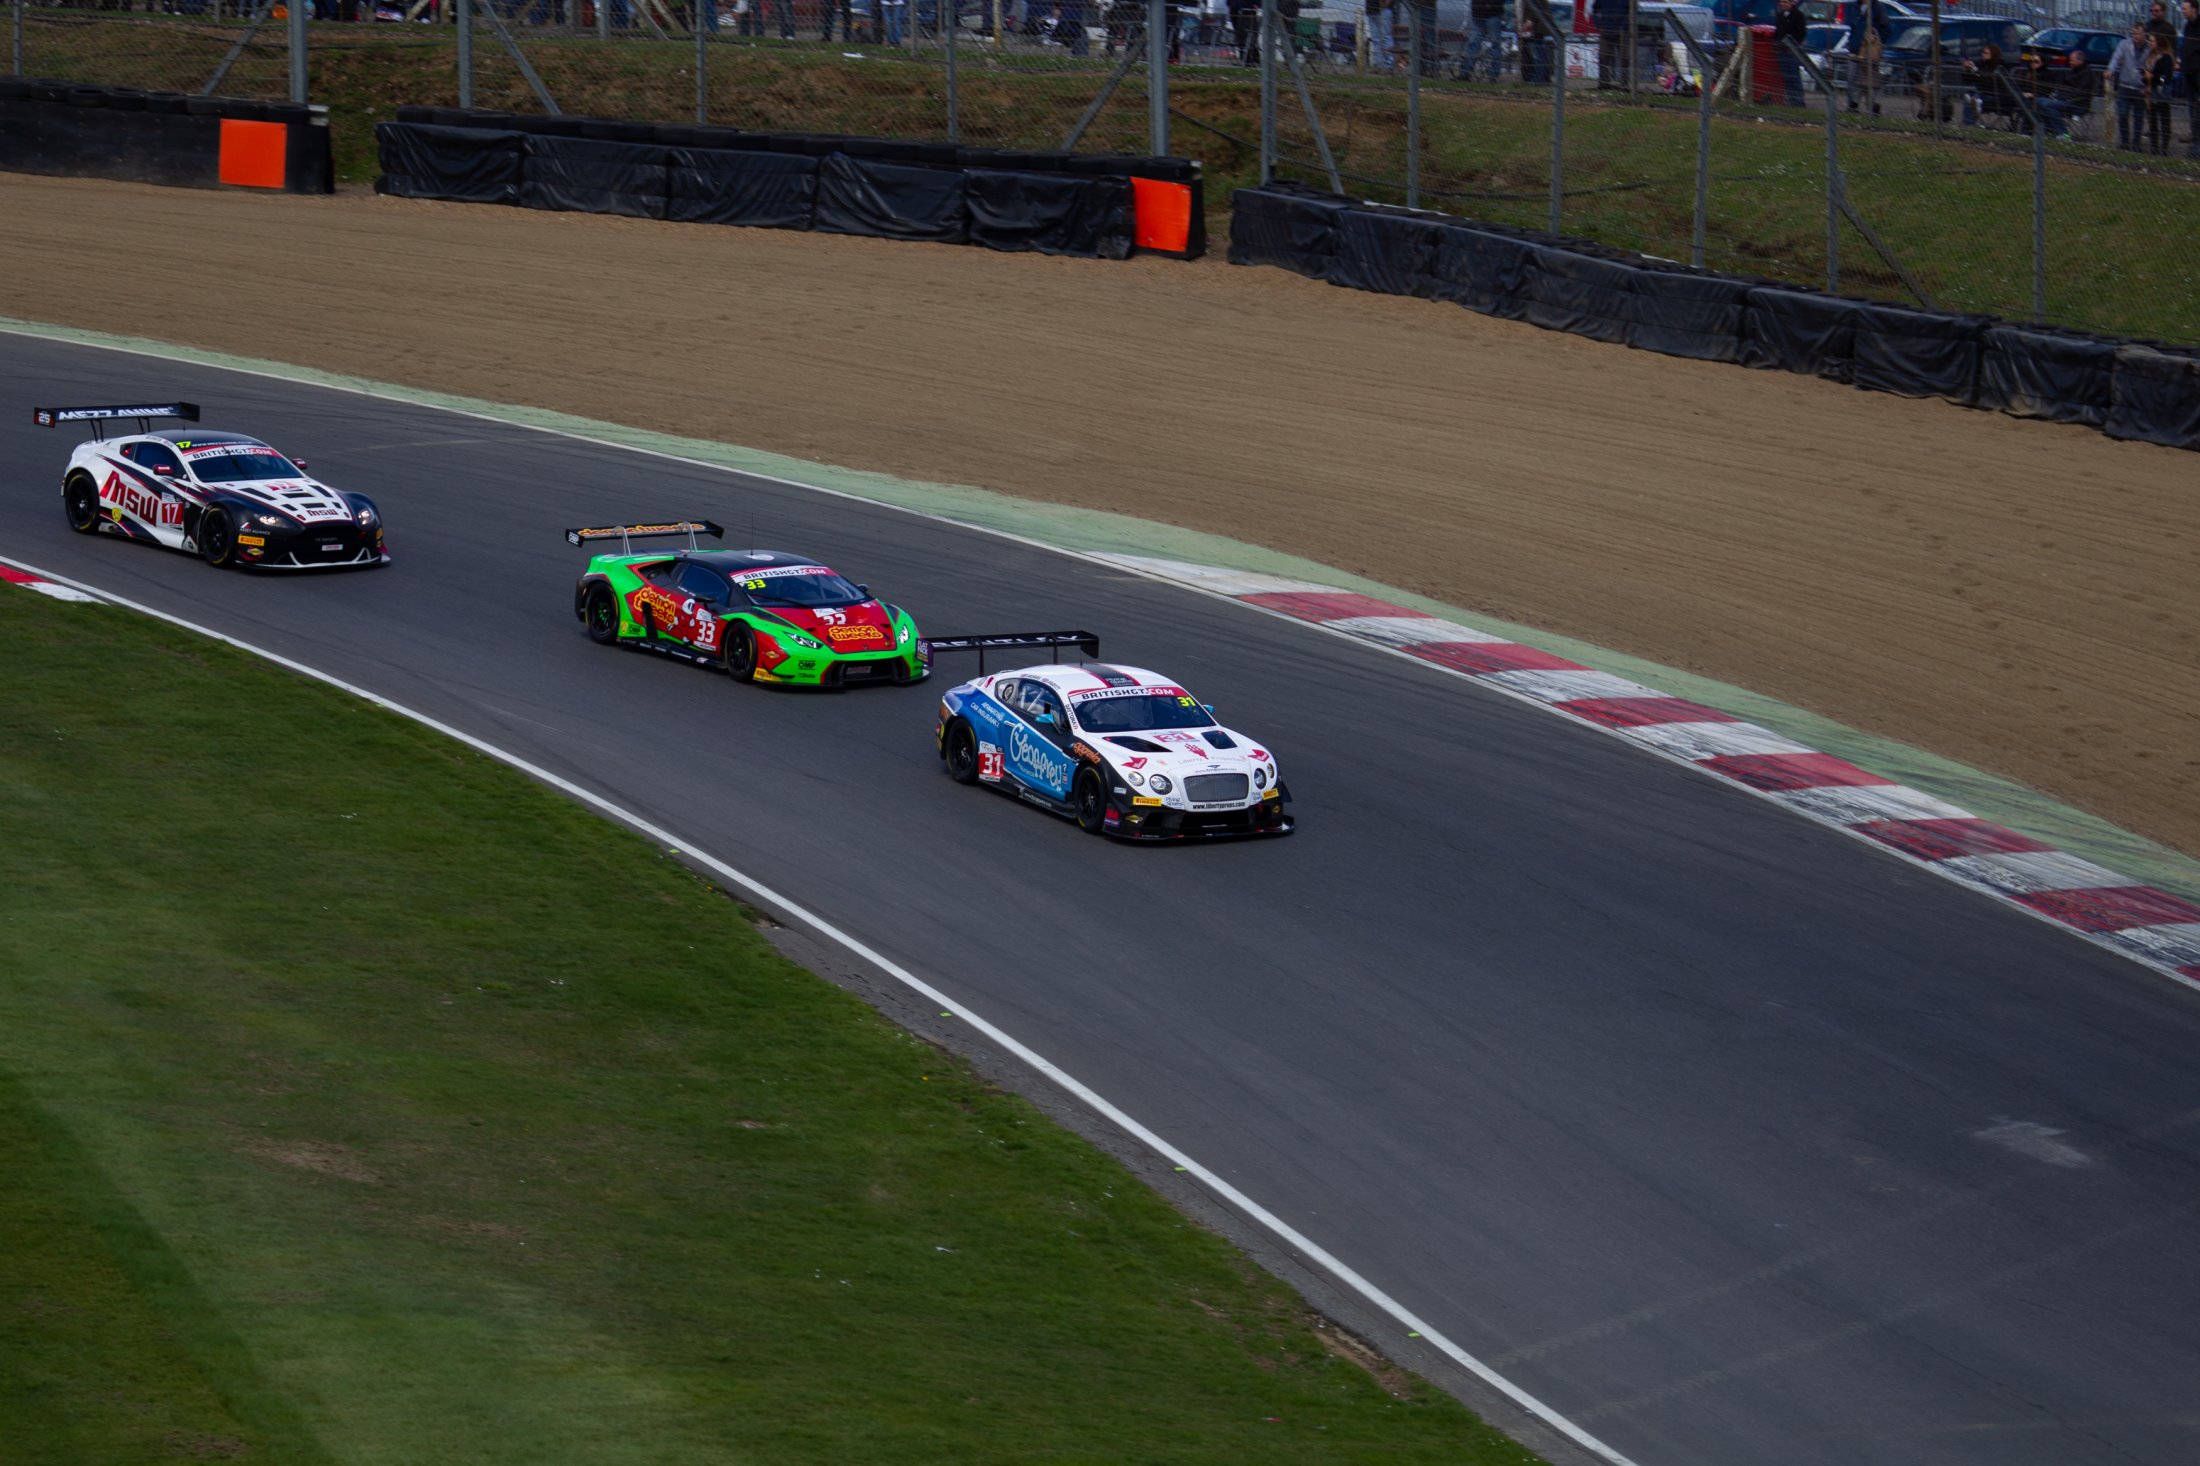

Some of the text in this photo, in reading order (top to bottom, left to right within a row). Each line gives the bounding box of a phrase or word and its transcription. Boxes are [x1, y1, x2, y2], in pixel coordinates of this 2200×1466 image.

[176, 441, 192, 449] 17
[99, 470, 159, 527] MSW
[164, 503, 179, 524] 17
[306, 509, 338, 517] MSW
[743, 568, 826, 580] BRITISHGT.COM
[745, 579, 767, 590] 33
[697, 620, 716, 643] 33
[797, 660, 815, 669] OMP
[1081, 687, 1175, 700] BRITISHGT.COM
[1177, 696, 1196, 707] 31
[982, 753, 1001, 776] 31
[1192, 801, 1246, 811] www.libertyprops.com
